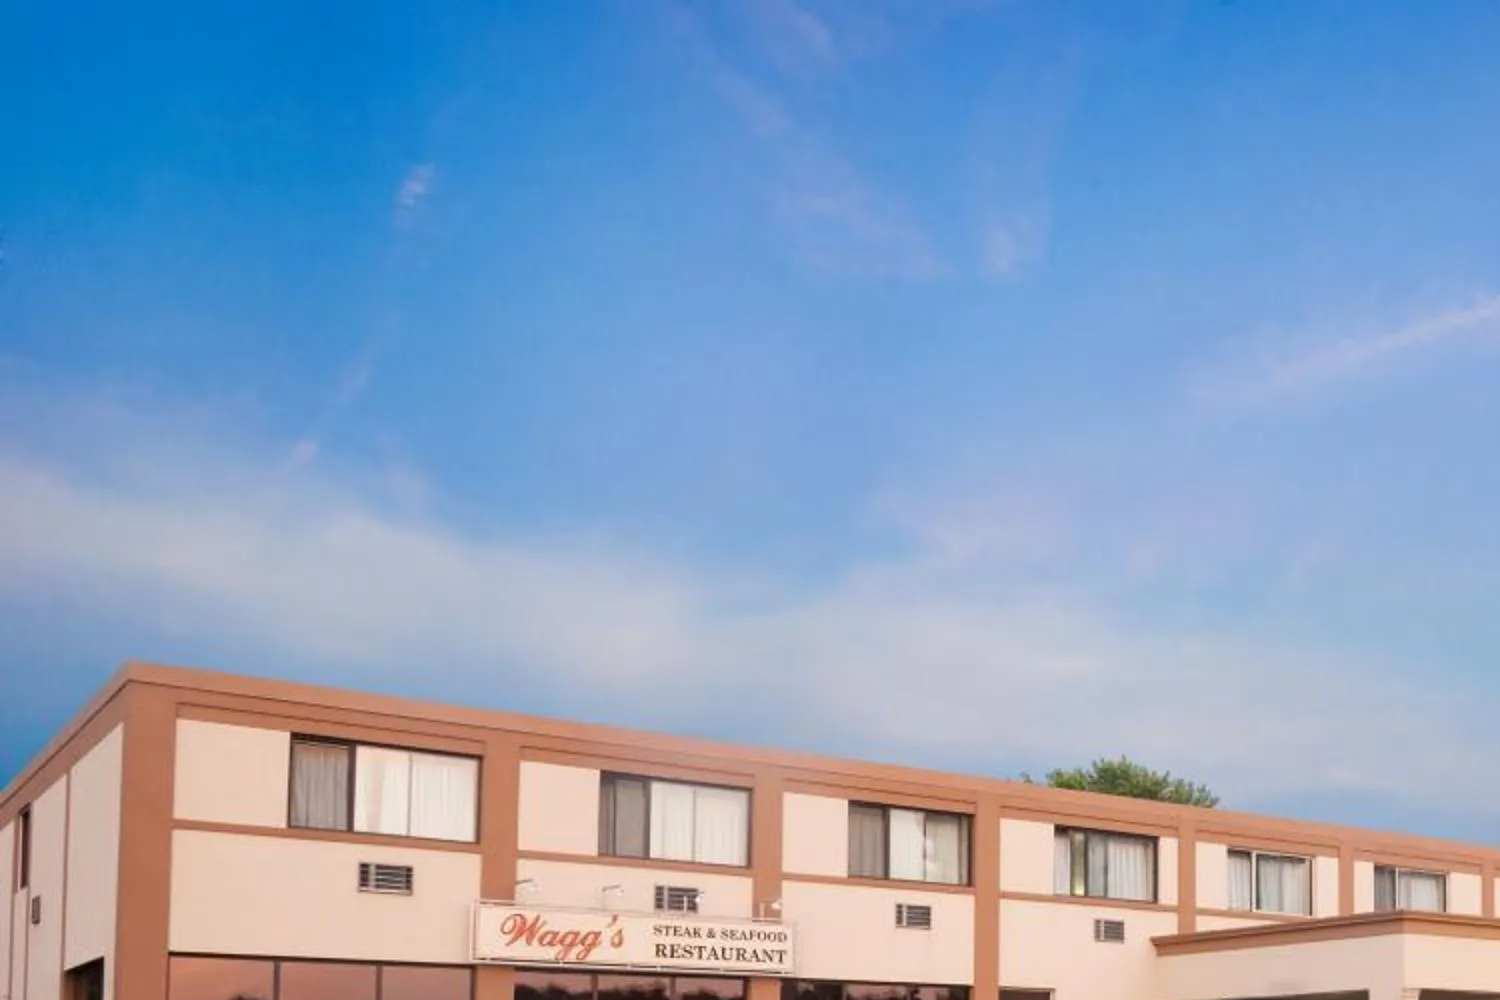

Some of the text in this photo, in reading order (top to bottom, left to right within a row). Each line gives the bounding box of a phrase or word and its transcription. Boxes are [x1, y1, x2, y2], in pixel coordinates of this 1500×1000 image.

[500, 913, 624, 960] Wagg's
[653, 924, 788, 943] STEAK & SEAFOOD
[654, 943, 788, 965] RESTAURANT
